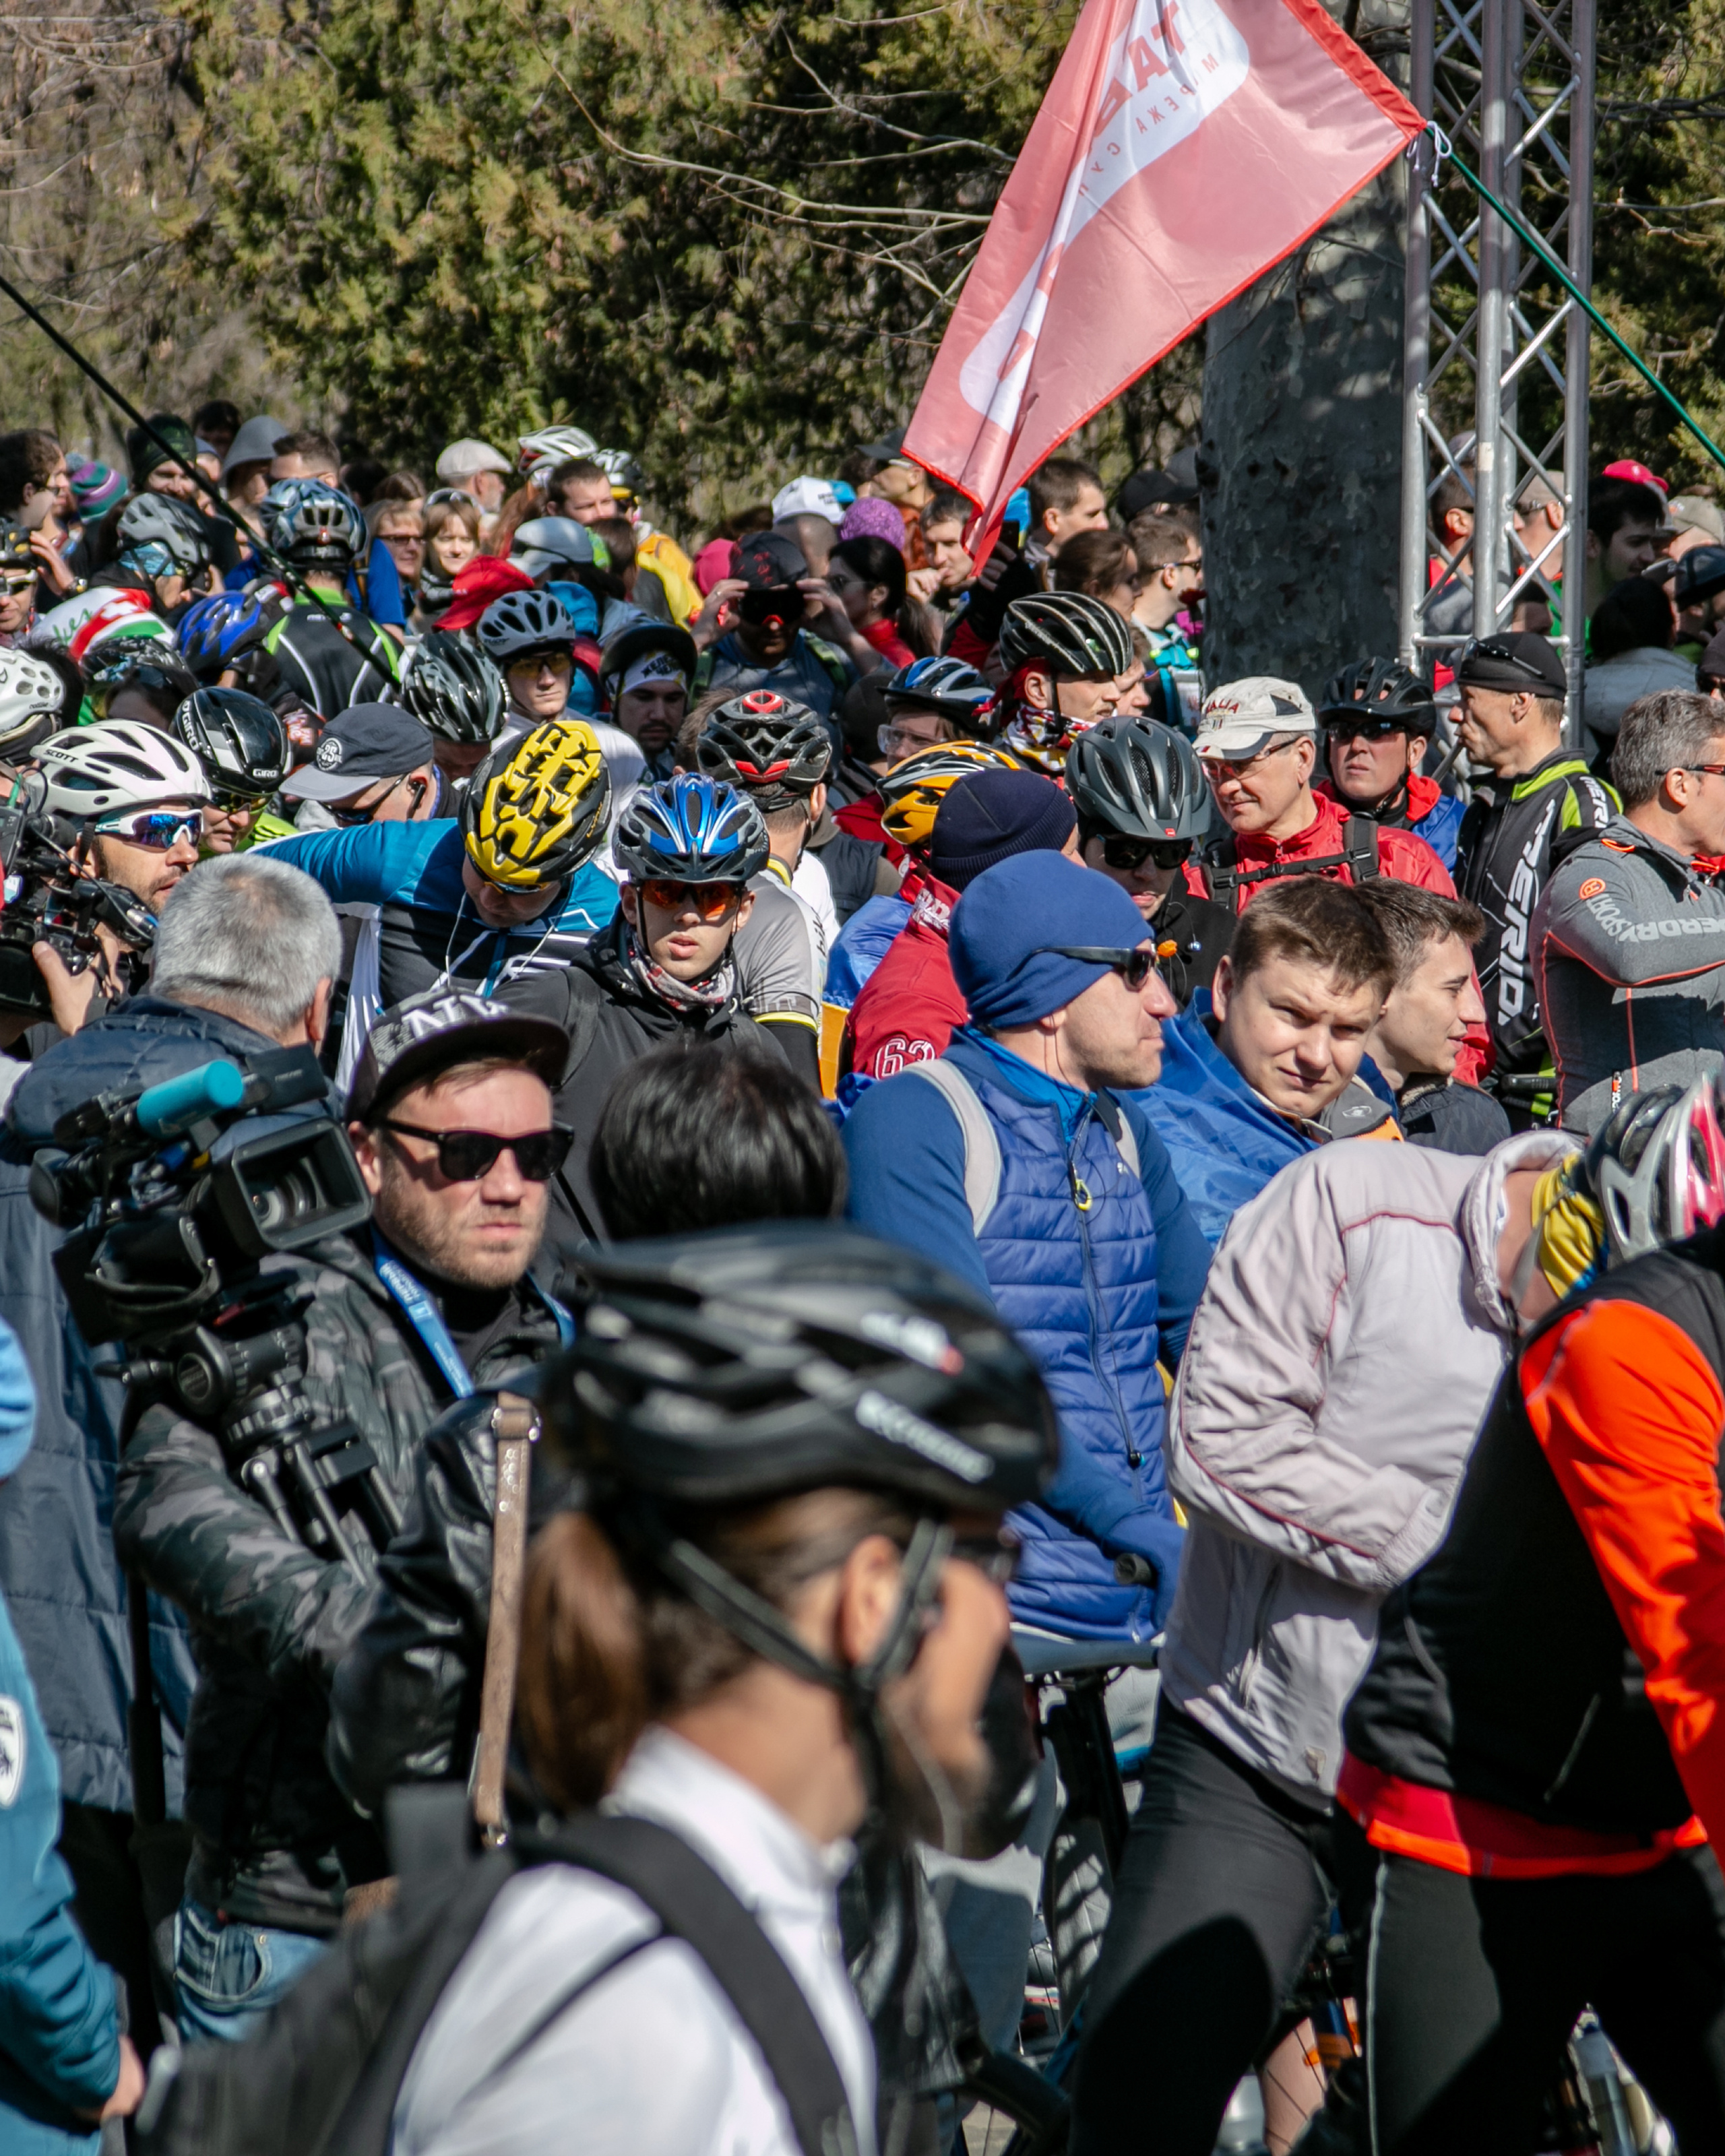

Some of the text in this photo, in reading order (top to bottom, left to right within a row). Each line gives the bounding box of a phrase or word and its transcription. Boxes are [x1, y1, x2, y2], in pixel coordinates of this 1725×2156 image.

[181, 713, 201, 751] GIRO
[44, 749, 79, 763] SCOTT
[321, 744, 338, 762] 25
[253, 768, 278, 778] GIRO
[1498, 798, 1555, 1026] MERID
[1586, 893, 1725, 943] ERDRY SPORT
